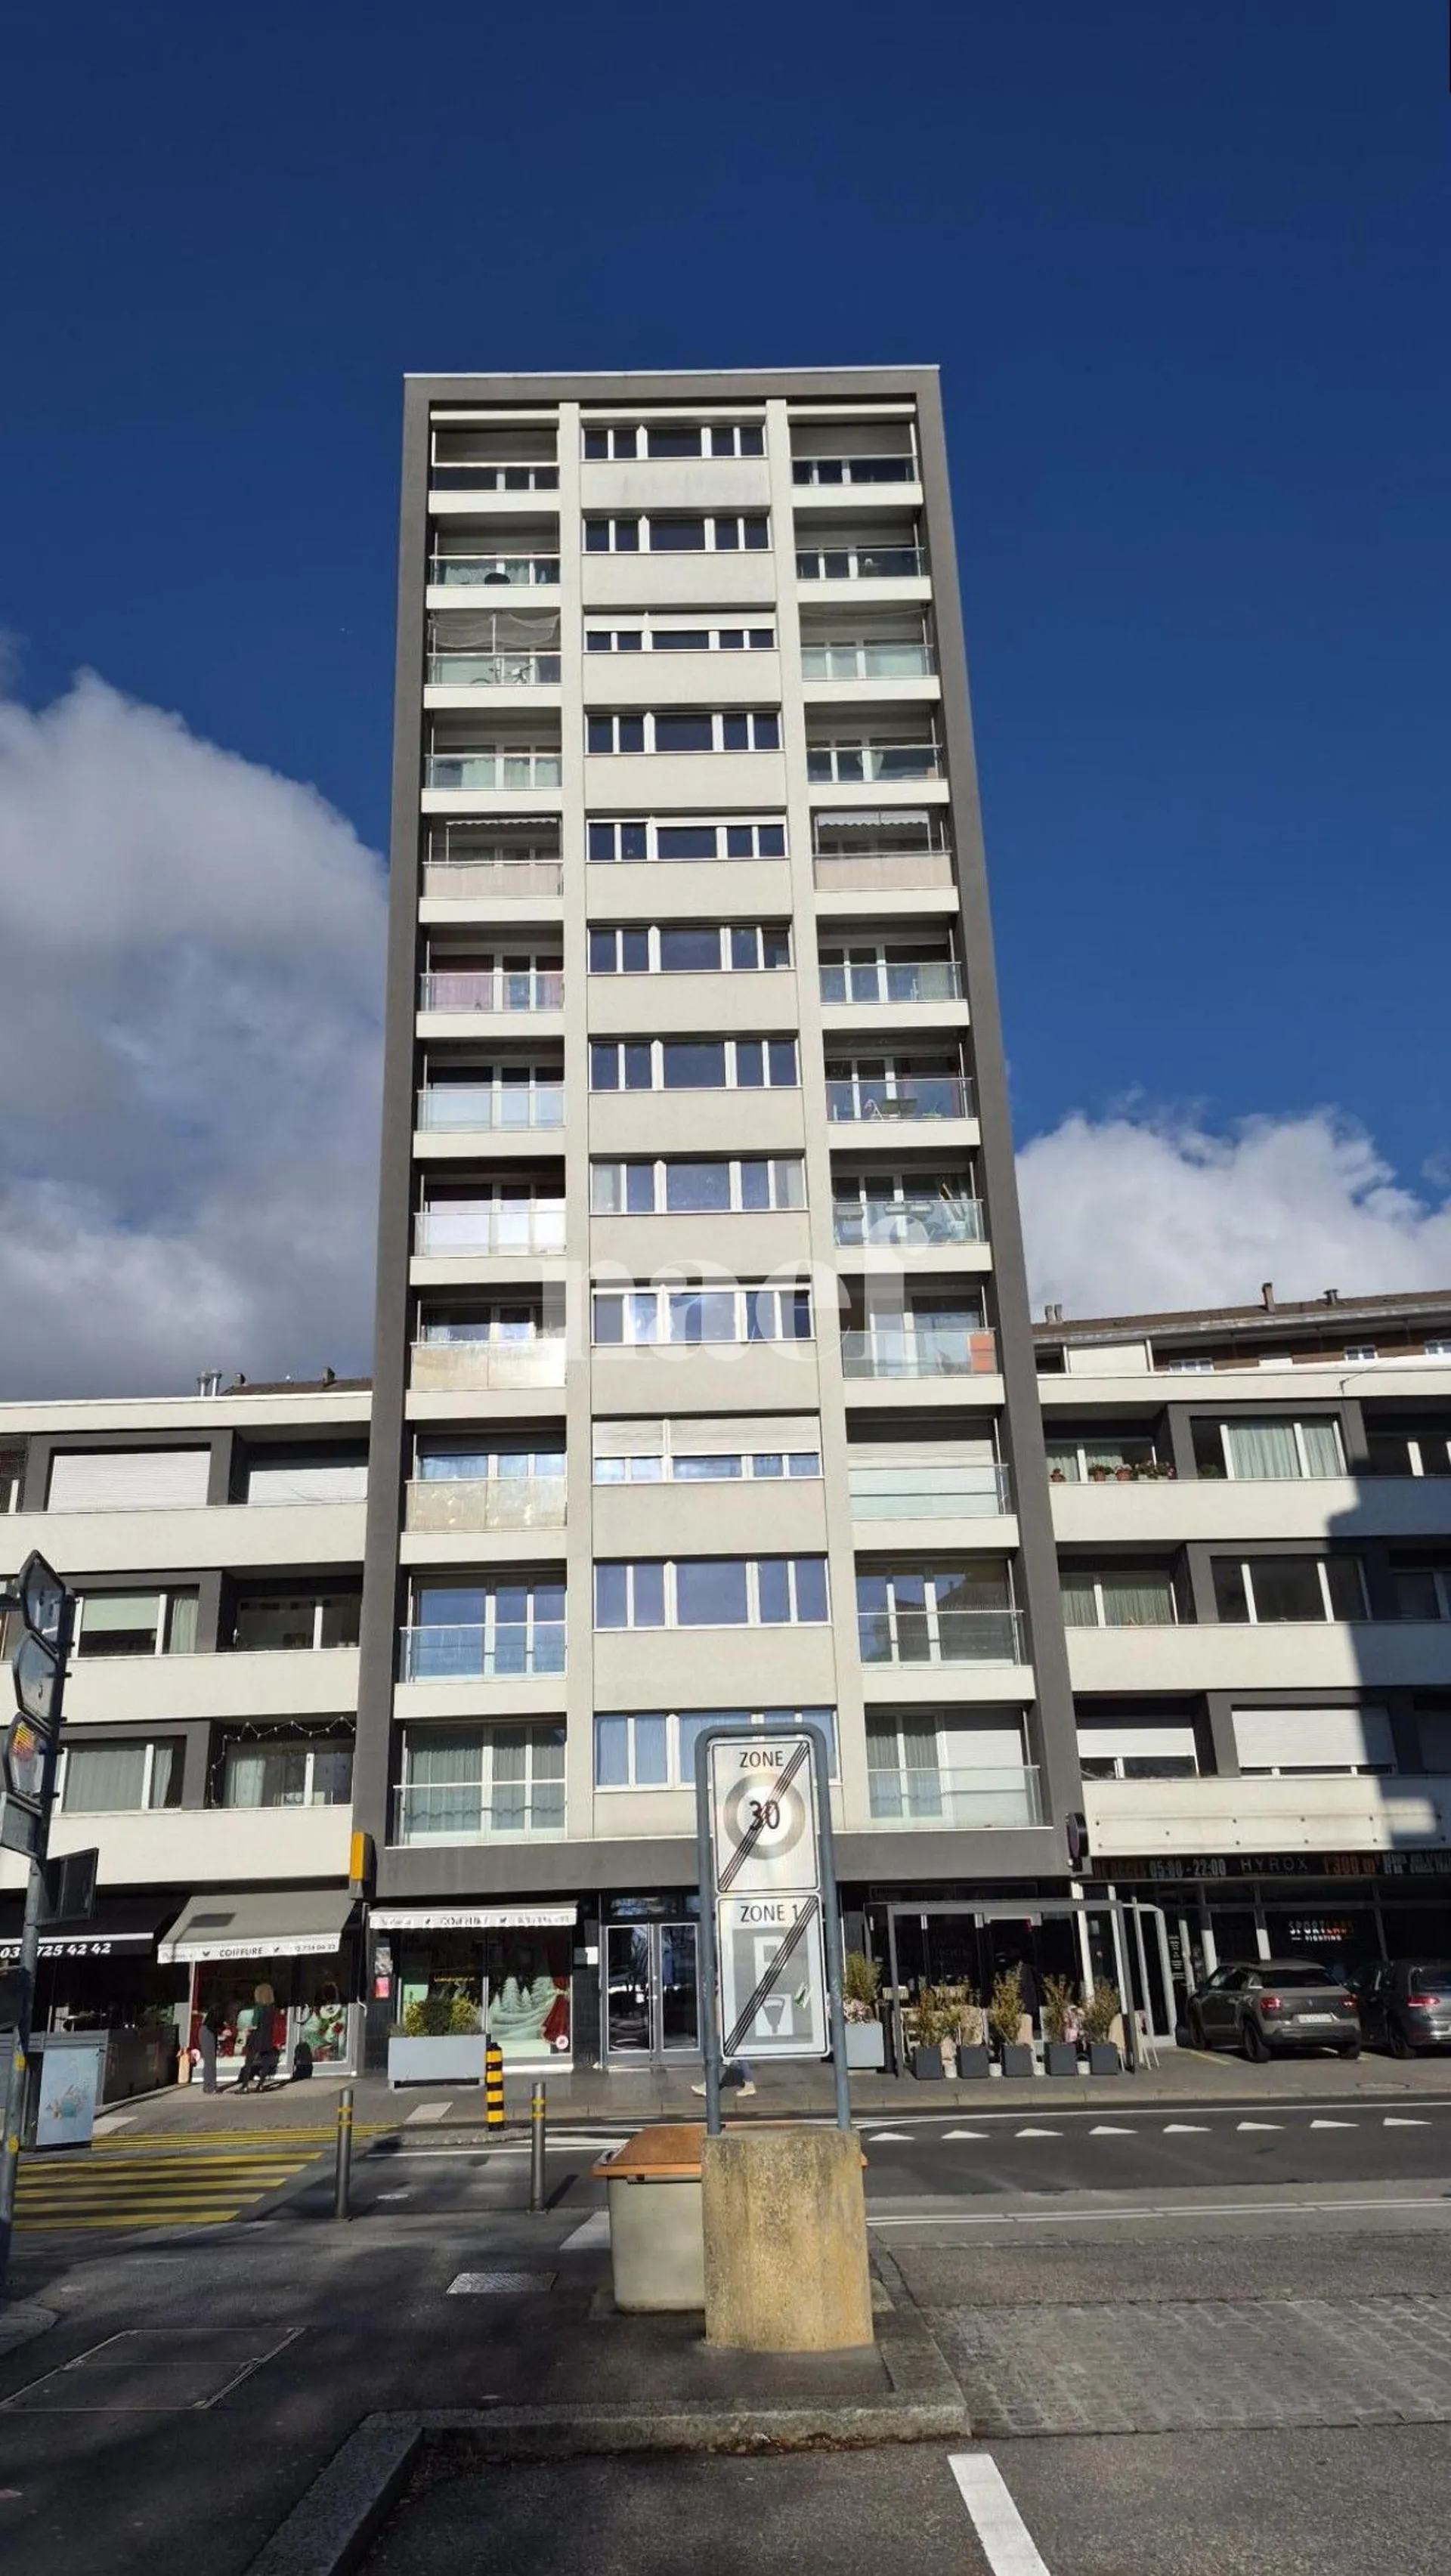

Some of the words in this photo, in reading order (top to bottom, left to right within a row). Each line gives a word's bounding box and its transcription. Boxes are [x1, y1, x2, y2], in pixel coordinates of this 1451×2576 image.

[739, 1751, 784, 1768] ZONE
[749, 1800, 781, 1829] 30
[1240, 1857, 1308, 1871] HYROX
[740, 1904, 784, 1922] ZONE
[791, 1903, 800, 1922] 1
[0, 1947, 21, 1959] 03
[36, 1944, 63, 1957] 725
[67, 1944, 88, 1956] 42
[91, 1943, 112, 1955] 42
[219, 1947, 264, 1957] COIFFURE
